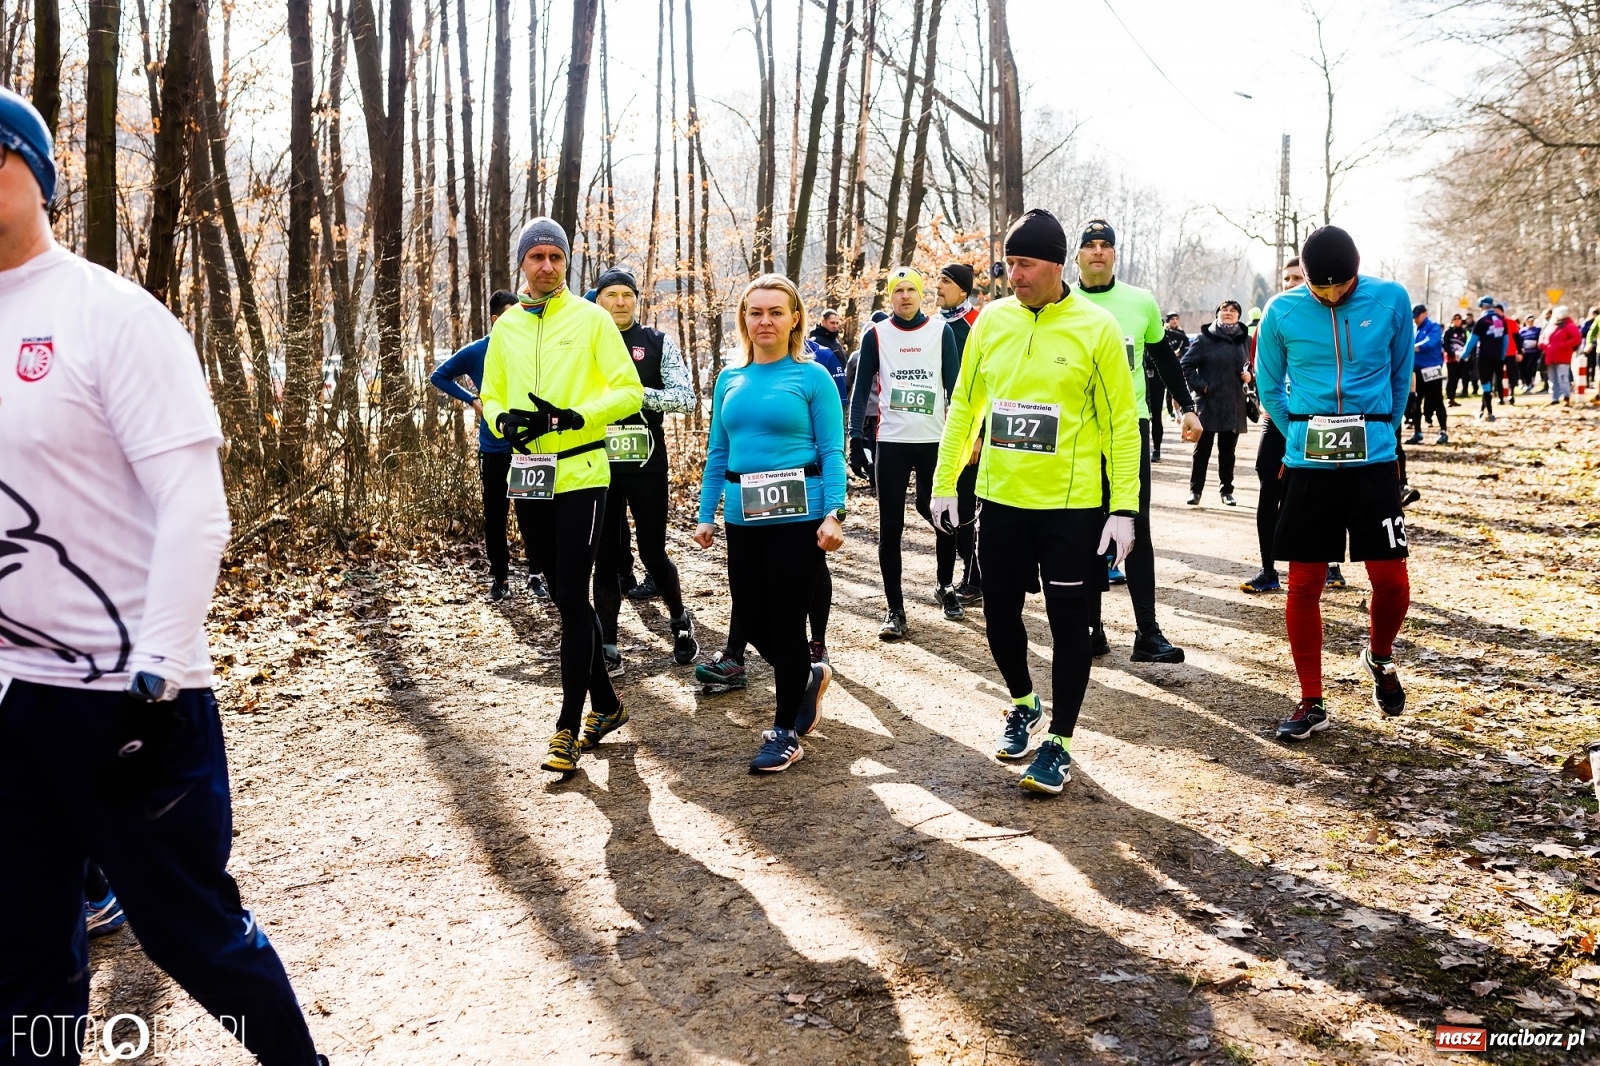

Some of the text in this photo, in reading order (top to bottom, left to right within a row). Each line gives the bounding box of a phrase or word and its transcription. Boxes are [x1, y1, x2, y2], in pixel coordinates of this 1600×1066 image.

[900, 390, 926, 406] 166
[1017, 402, 1052, 411] Twardziela
[1006, 416, 1041, 438] 127
[609, 437, 638, 451] 081
[1317, 431, 1353, 449] 124
[520, 469, 546, 487] 102
[764, 471, 798, 479] Twardziela
[757, 485, 789, 506] 101
